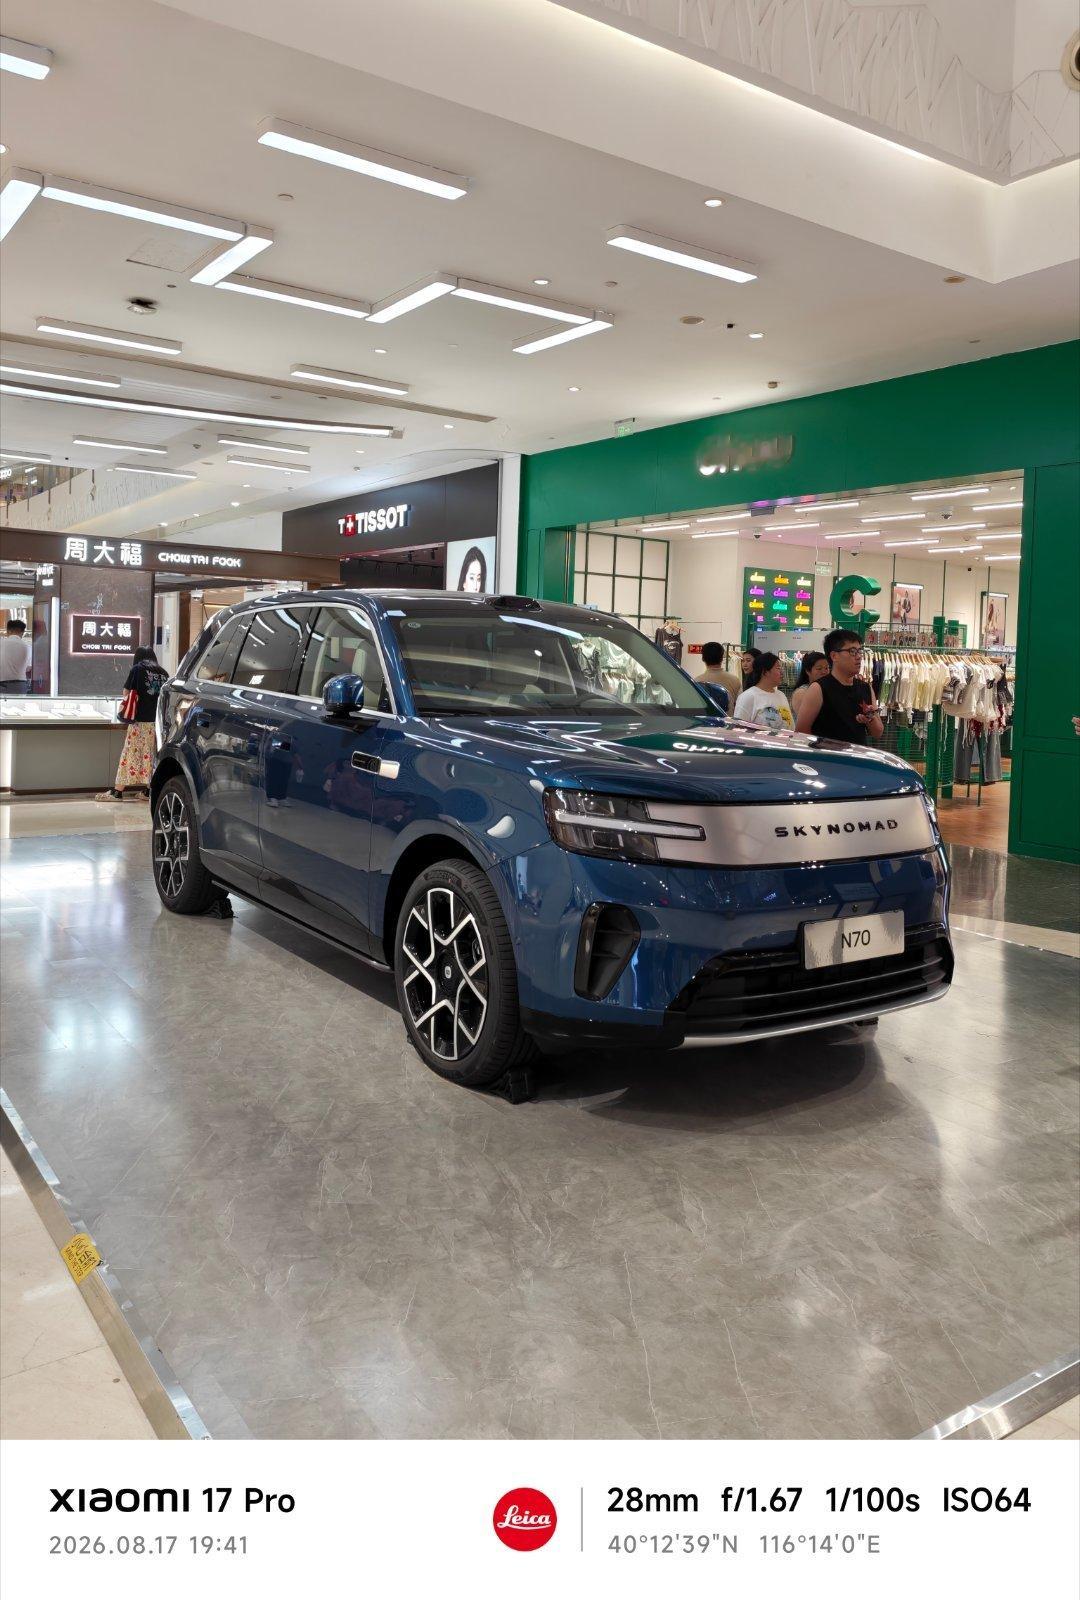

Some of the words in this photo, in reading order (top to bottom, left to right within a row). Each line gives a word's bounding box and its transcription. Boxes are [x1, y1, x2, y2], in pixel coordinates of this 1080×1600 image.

[355, 503, 408, 534] TISSOT
[63, 536, 143, 566] 周大福
[157, 552, 191, 564] CHOW
[191, 554, 209, 565] TAI
[212, 556, 241, 568] FOOK
[81, 621, 132, 638] 周大福
[81, 643, 101, 651] CHOW
[774, 819, 899, 838] SKYNOMAD
[841, 929, 871, 949] N70
